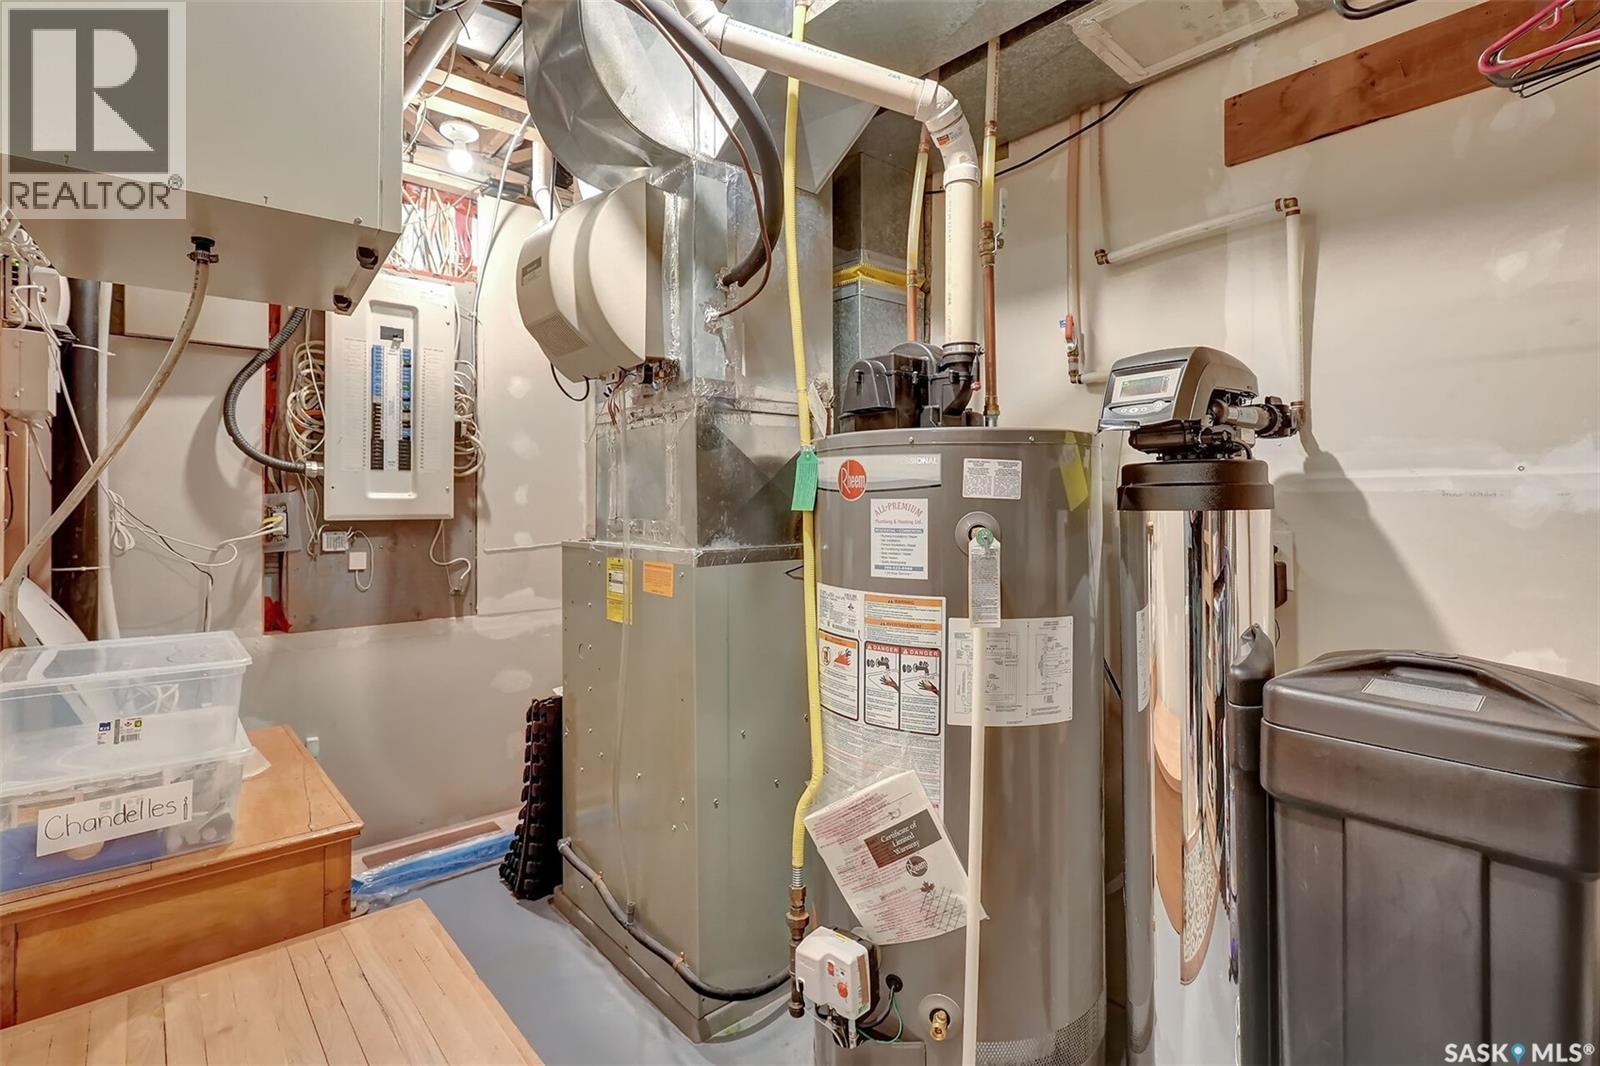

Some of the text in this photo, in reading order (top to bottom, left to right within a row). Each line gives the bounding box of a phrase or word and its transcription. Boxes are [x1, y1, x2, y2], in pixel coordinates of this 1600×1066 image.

[840, 461, 866, 493] Rheem
[873, 645, 900, 653] DANGER
[44, 798, 177, 840] Chandelles
[880, 826, 909, 843] Certificate
[892, 832, 915, 847] Limited
[893, 840, 920, 855] Warranty
